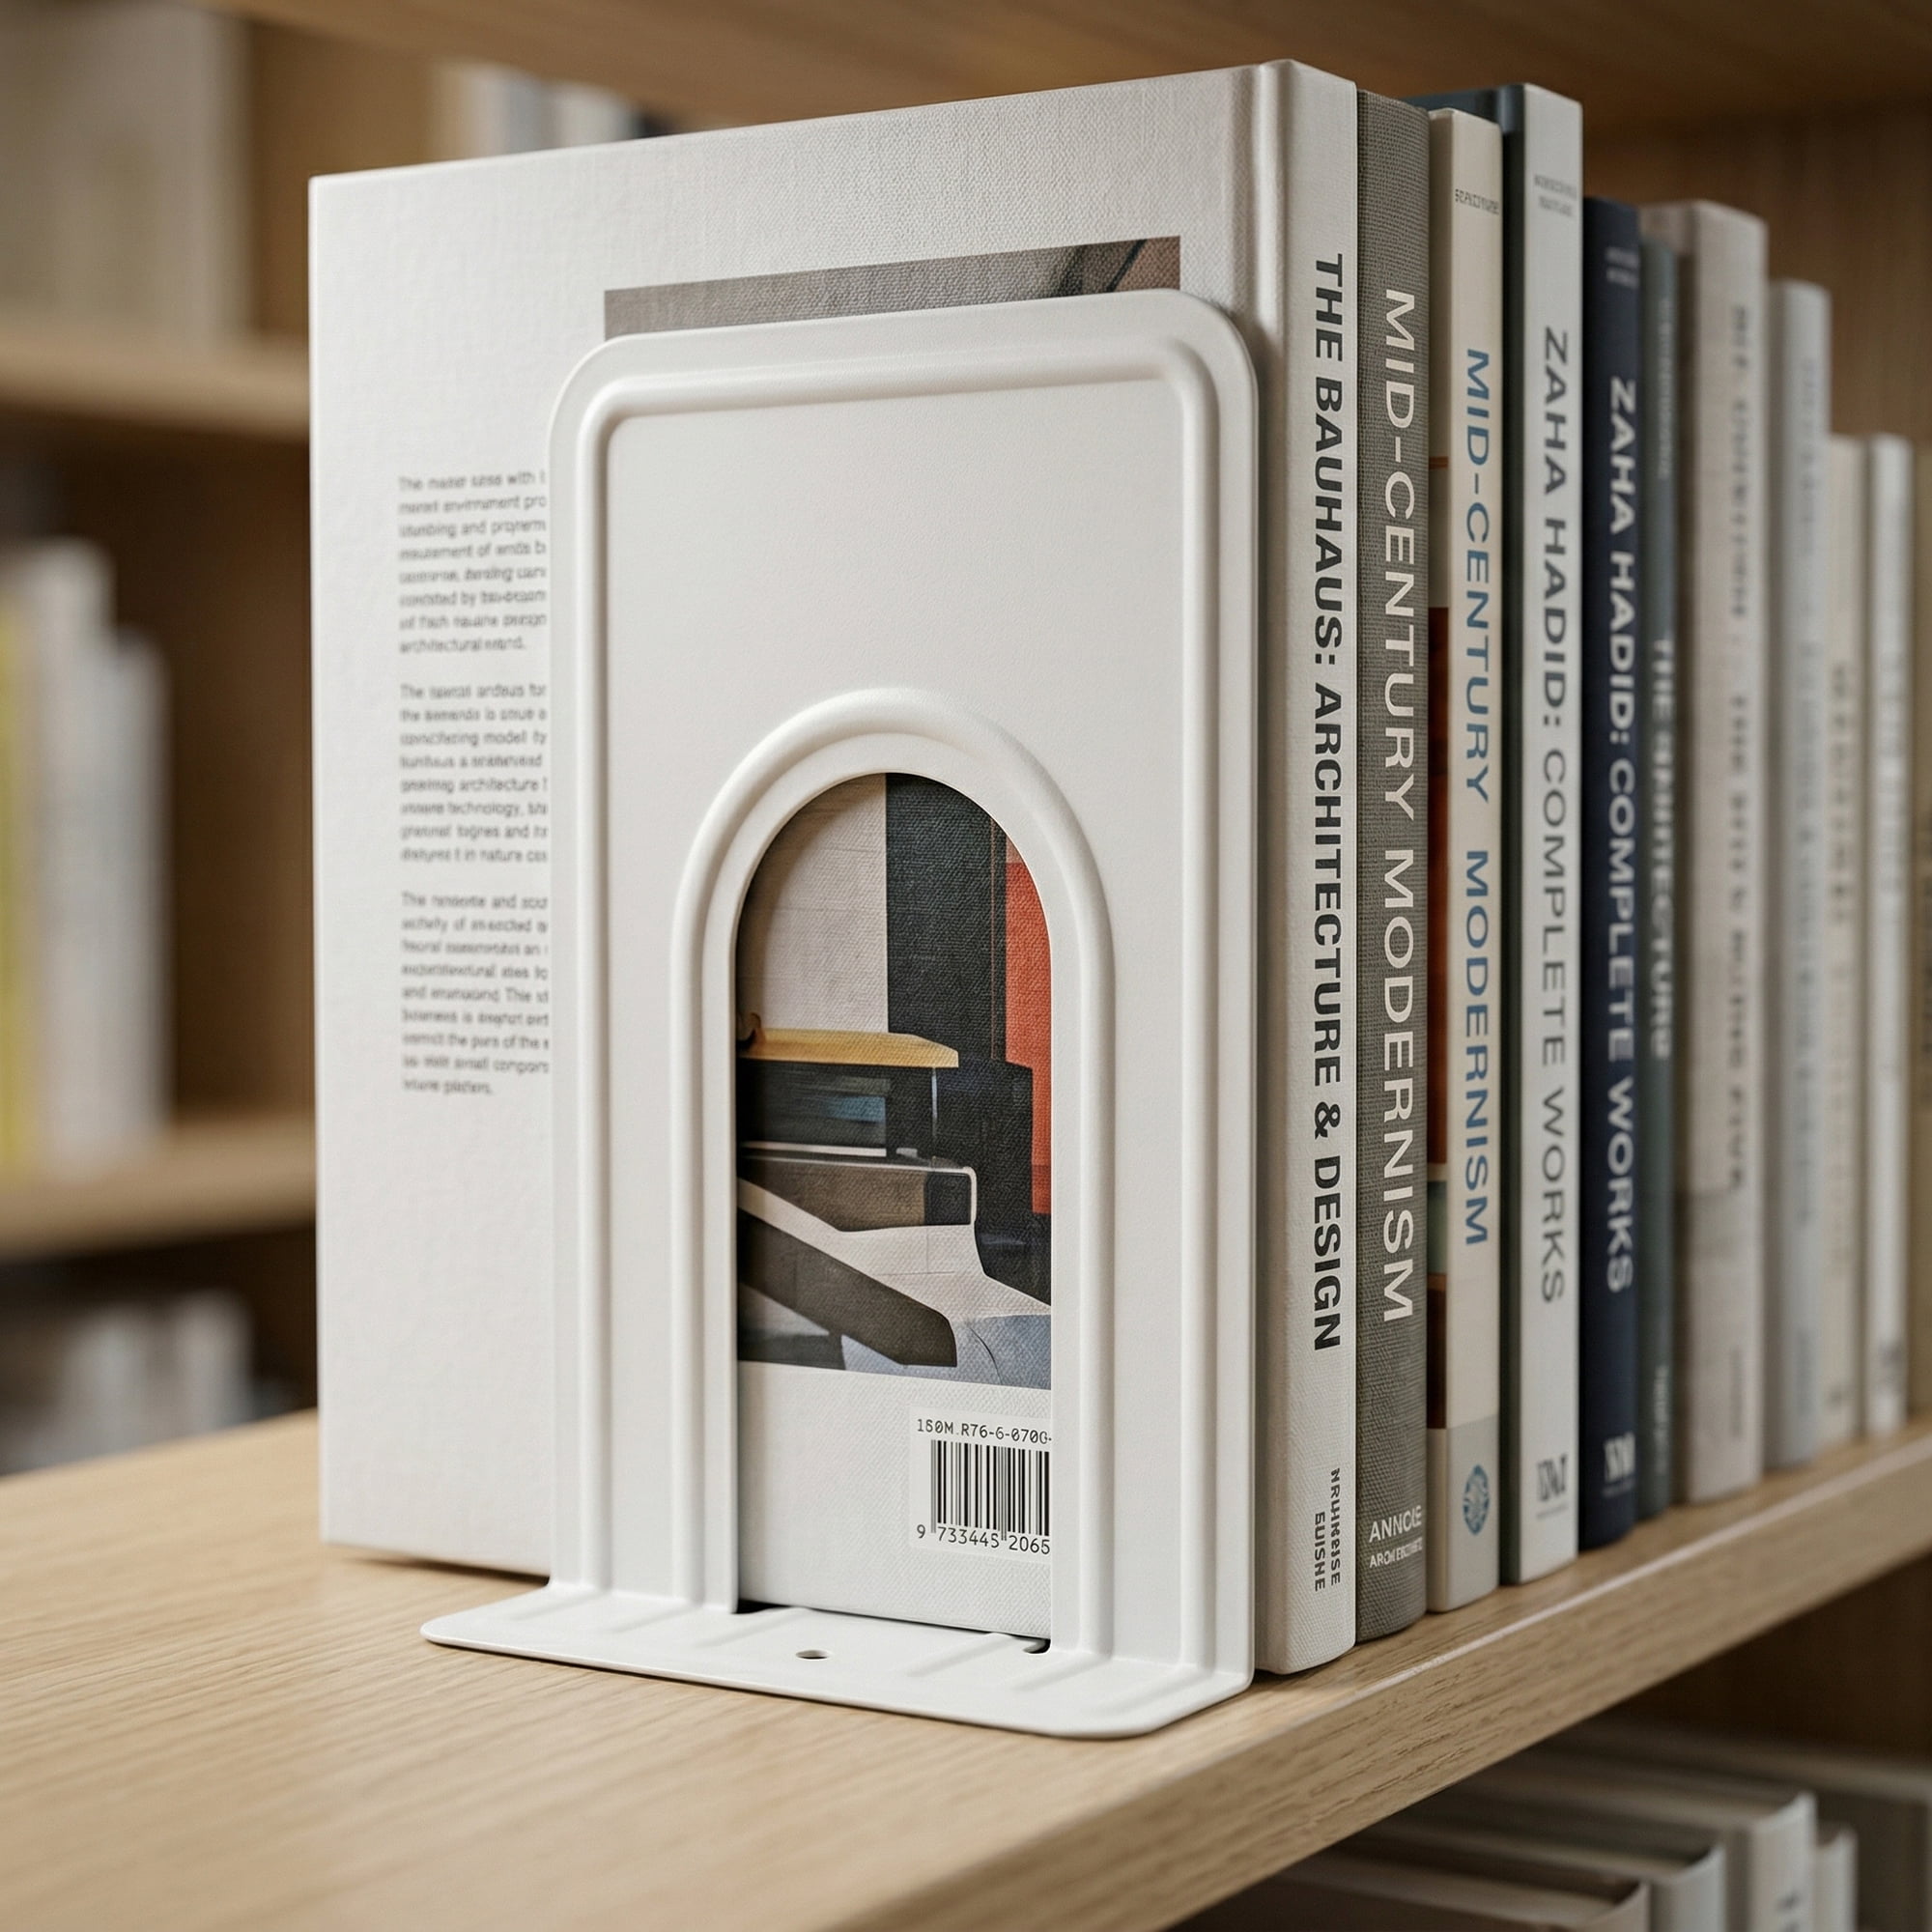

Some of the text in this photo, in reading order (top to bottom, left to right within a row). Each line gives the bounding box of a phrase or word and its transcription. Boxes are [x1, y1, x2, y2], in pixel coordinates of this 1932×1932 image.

[1314, 253, 1343, 1350] THE BAUHAUS: ARCHITECTURE & DESIGN
[1383, 289, 1415, 1321] MID-CENTURY MODERNISM
[1464, 349, 1491, 1245] MID-CENTURY MODERNISM
[1542, 326, 1568, 1303] ZAHA HADID: COMPLETE WORKS
[1606, 376, 1636, 1293] ZAHA HADID: COMPLETE WORKS
[917, 1524, 926, 1539] 9
